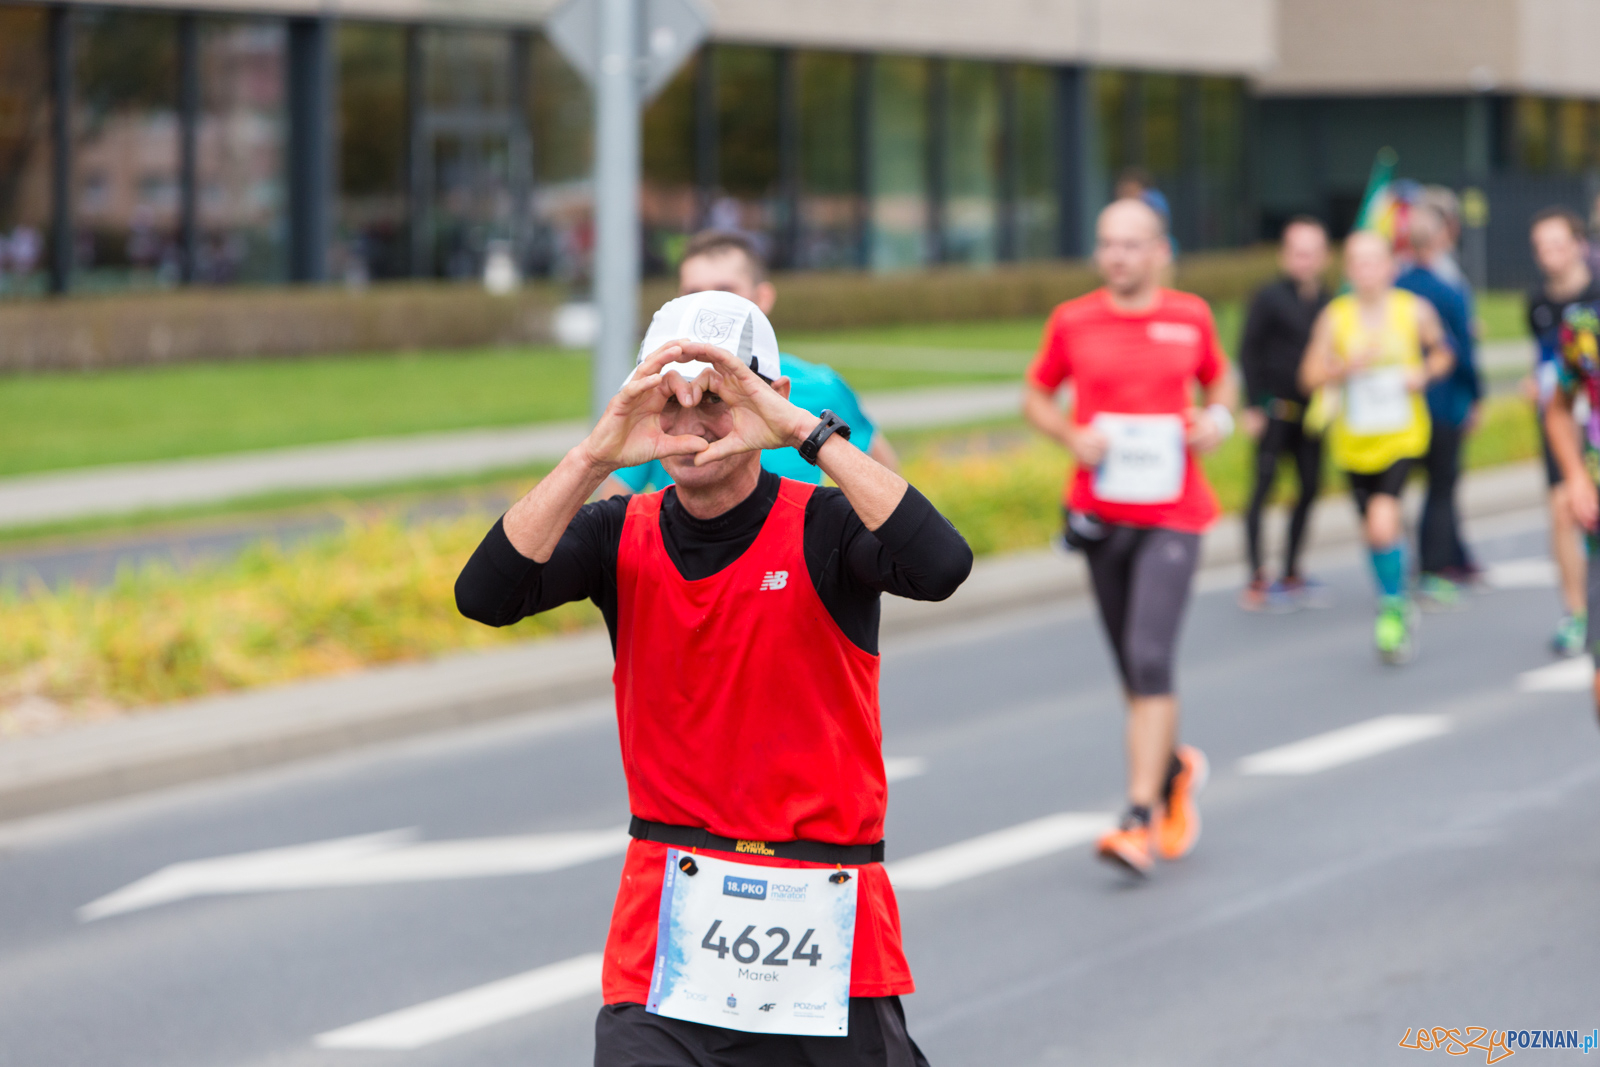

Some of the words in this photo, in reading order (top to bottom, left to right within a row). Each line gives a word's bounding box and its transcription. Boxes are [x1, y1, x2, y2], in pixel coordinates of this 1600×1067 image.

[760, 571, 789, 591] NB
[726, 881, 740, 892] 18.
[741, 883, 764, 895] PKO
[770, 891, 806, 899] maraton
[701, 919, 822, 967] 4624
[738, 968, 780, 982] Marek
